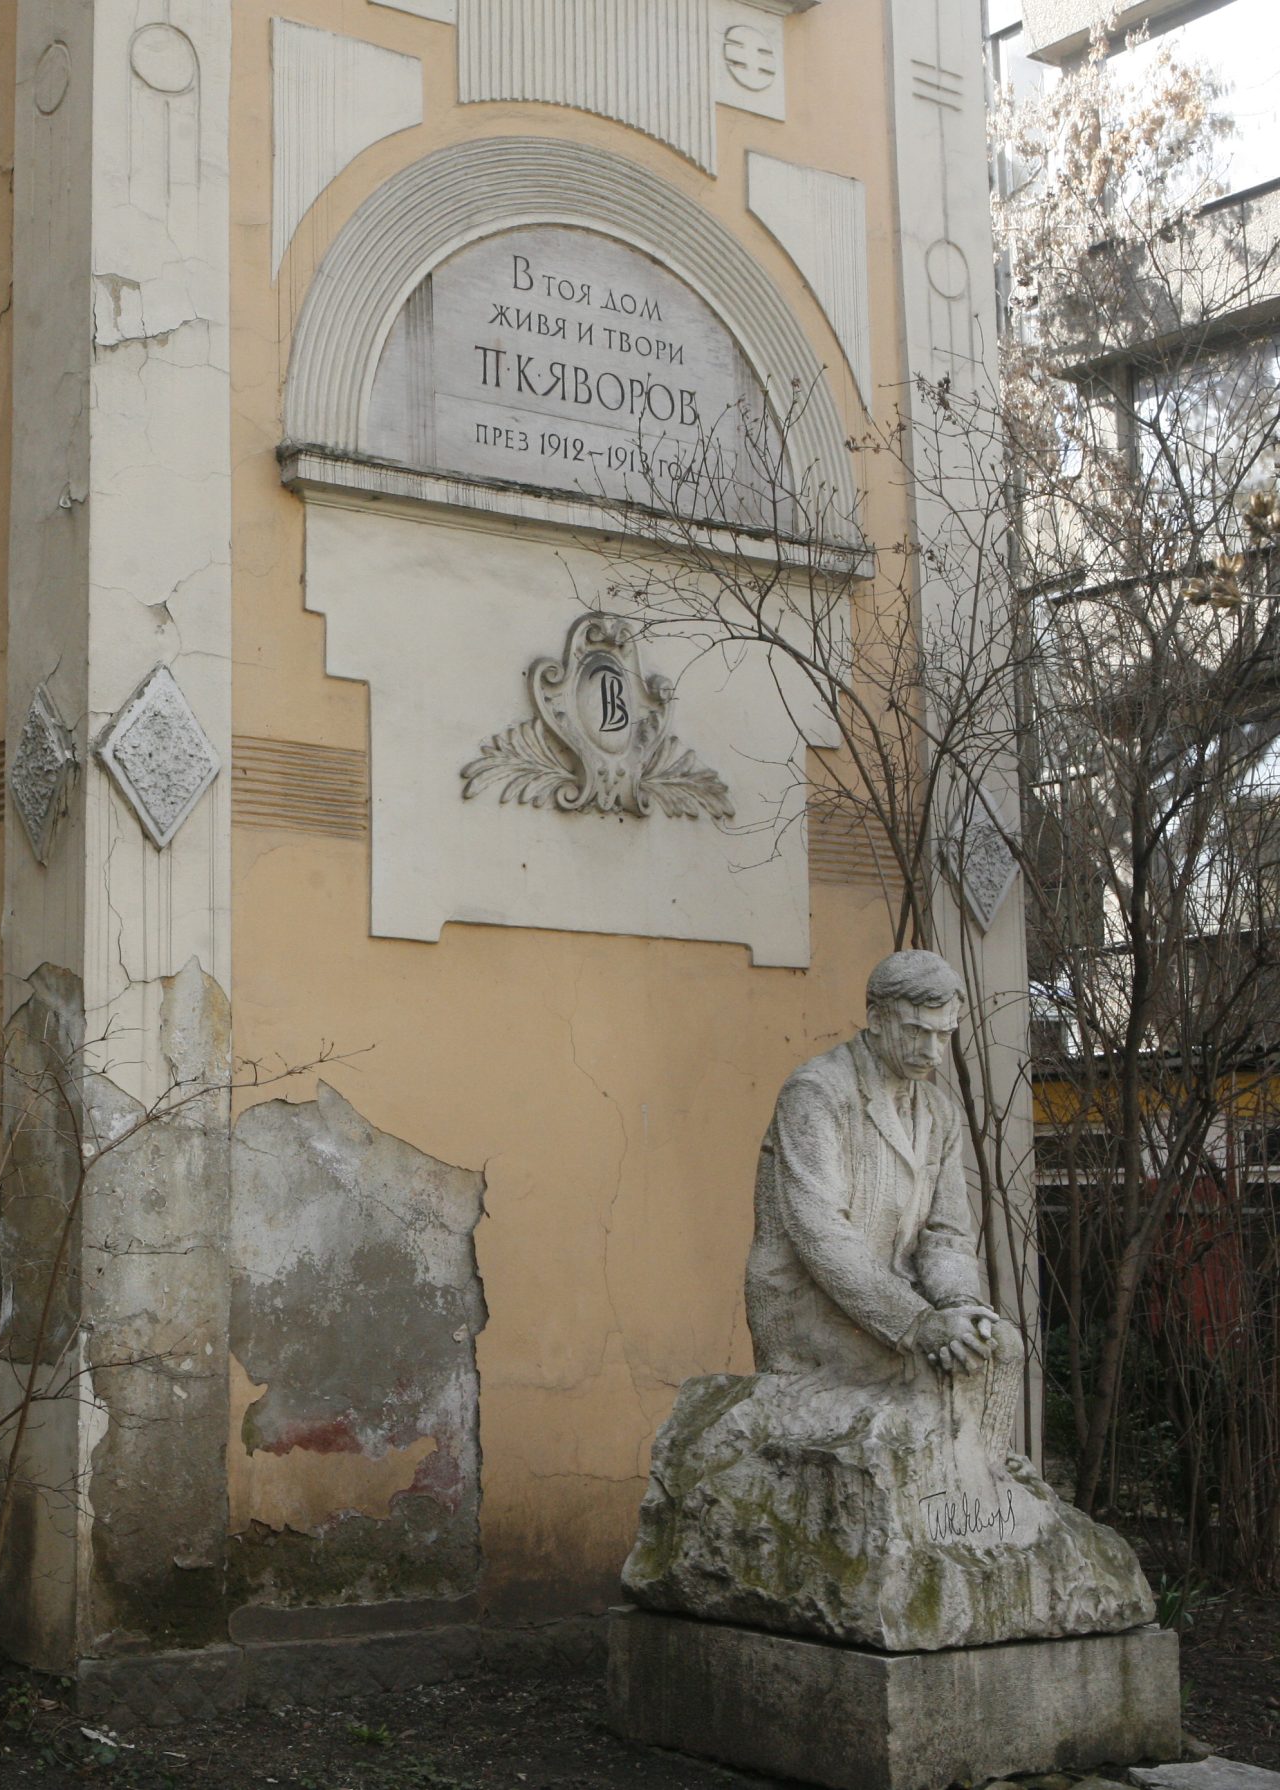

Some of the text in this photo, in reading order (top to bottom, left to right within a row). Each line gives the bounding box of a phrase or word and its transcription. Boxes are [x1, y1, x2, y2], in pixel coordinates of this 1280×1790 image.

[513, 255, 663, 322] В ТОЯ ДОМ
[488, 303, 684, 365] ЖИВЯ И ТВОРИ
[475, 423, 529, 451] ПРЕЗ
